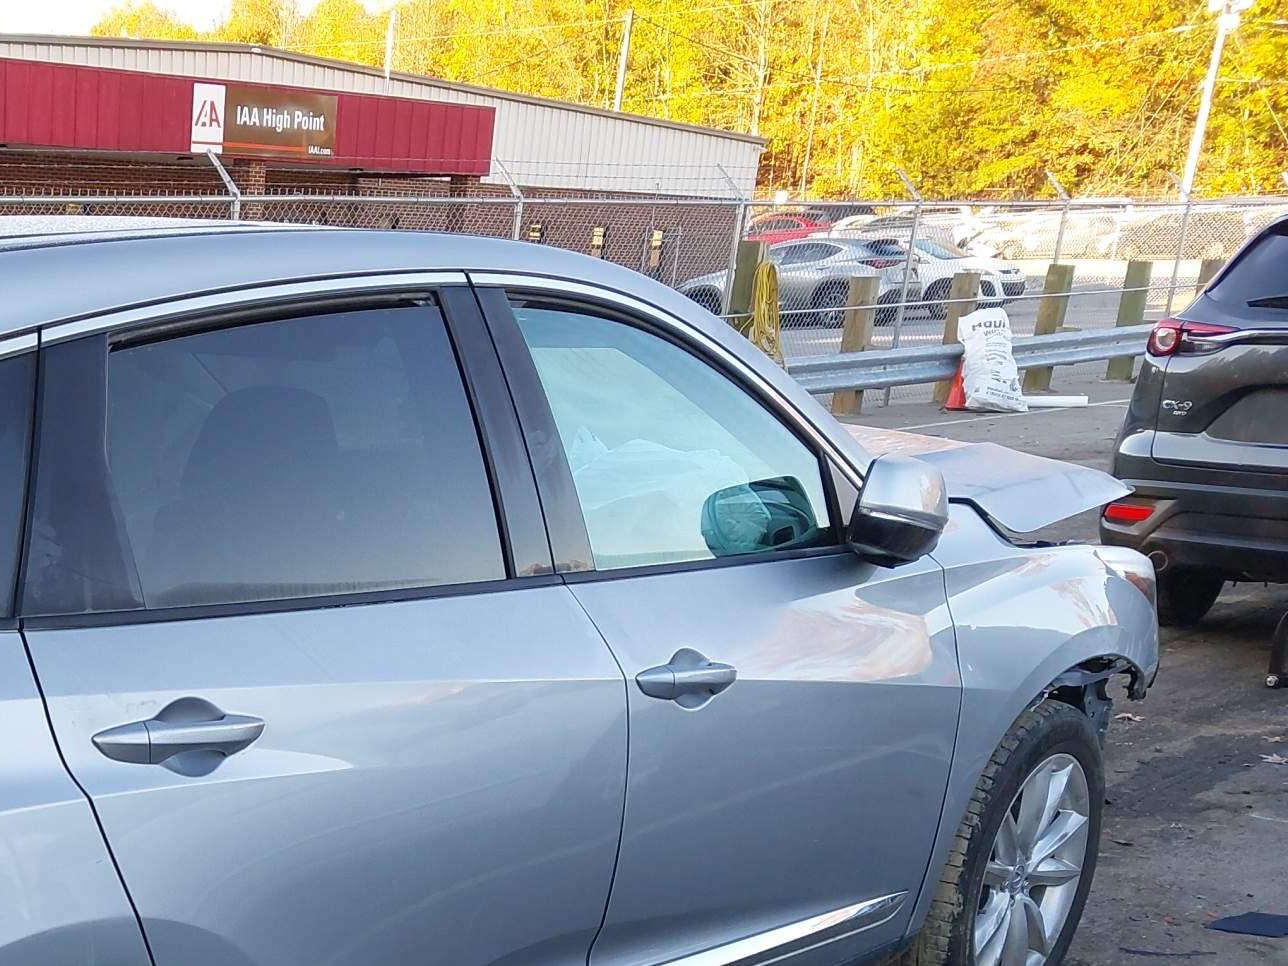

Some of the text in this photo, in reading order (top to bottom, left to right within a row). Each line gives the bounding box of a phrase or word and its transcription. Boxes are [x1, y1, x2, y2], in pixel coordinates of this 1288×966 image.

[236, 105, 325, 133] IAA High Point
[1162, 399, 1193, 410] CX-9
